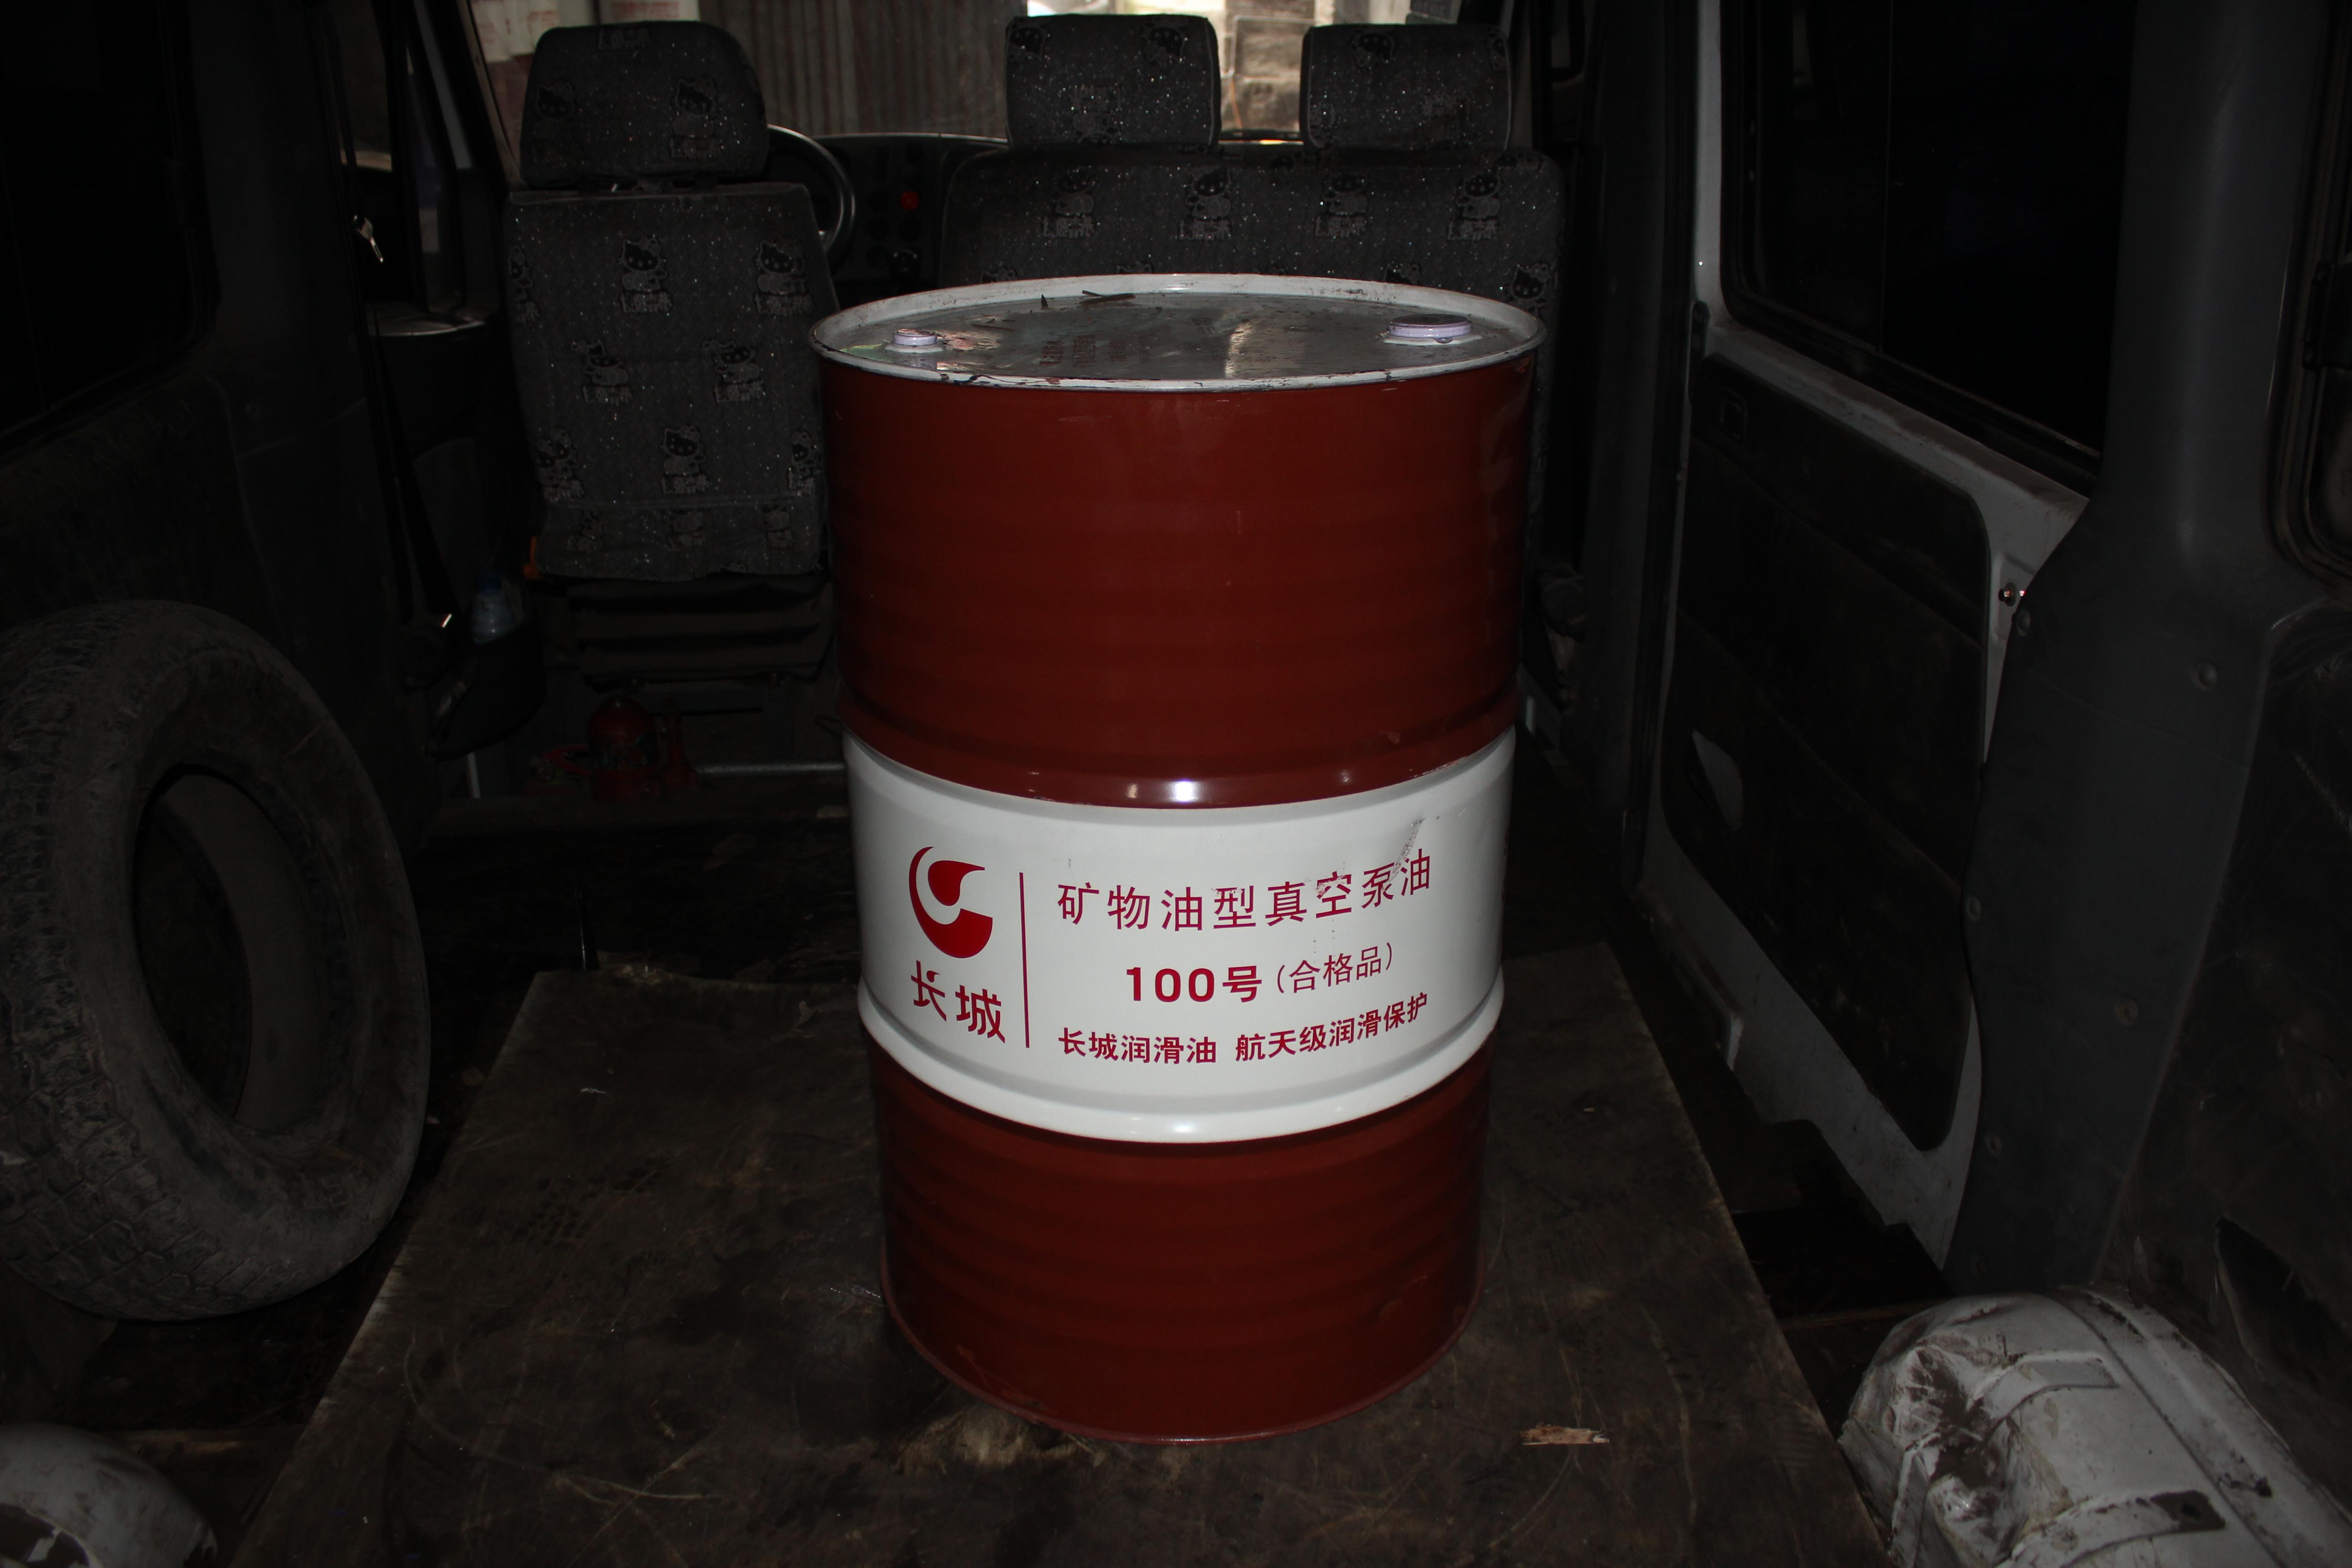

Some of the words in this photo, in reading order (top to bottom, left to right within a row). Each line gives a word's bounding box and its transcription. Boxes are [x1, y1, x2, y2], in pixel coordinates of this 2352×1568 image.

[1057, 849, 1431, 932] 矿物油型真空泵油
[910, 959, 1006, 1044] 长城
[1126, 965, 1263, 1003] 100号
[1058, 1027, 1217, 1065] 长城润滑油
[1235, 993, 1428, 1062] 航天级润滑保护
